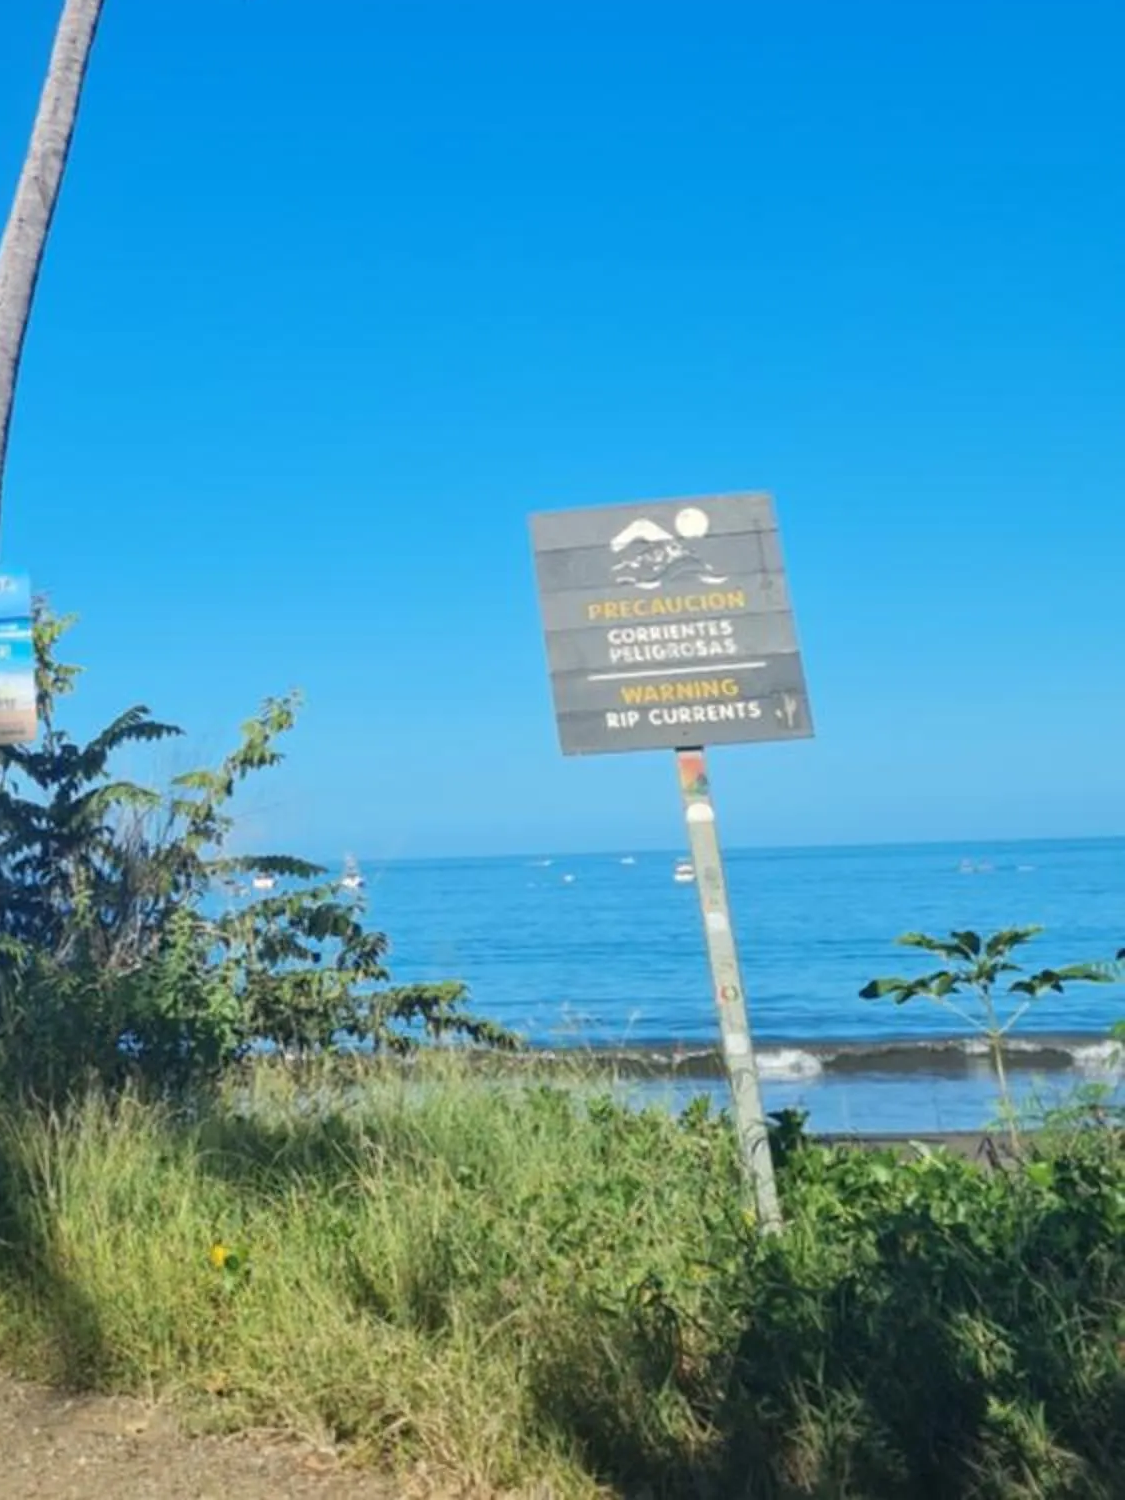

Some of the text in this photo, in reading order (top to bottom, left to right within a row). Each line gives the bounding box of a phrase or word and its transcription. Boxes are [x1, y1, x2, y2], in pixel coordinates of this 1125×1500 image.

[607, 620, 733, 644] CORRIENTES
[609, 638, 738, 663] PELIGROSAS
[621, 678, 739, 704] WARNING
[605, 701, 762, 729] RIP CURRENTS
